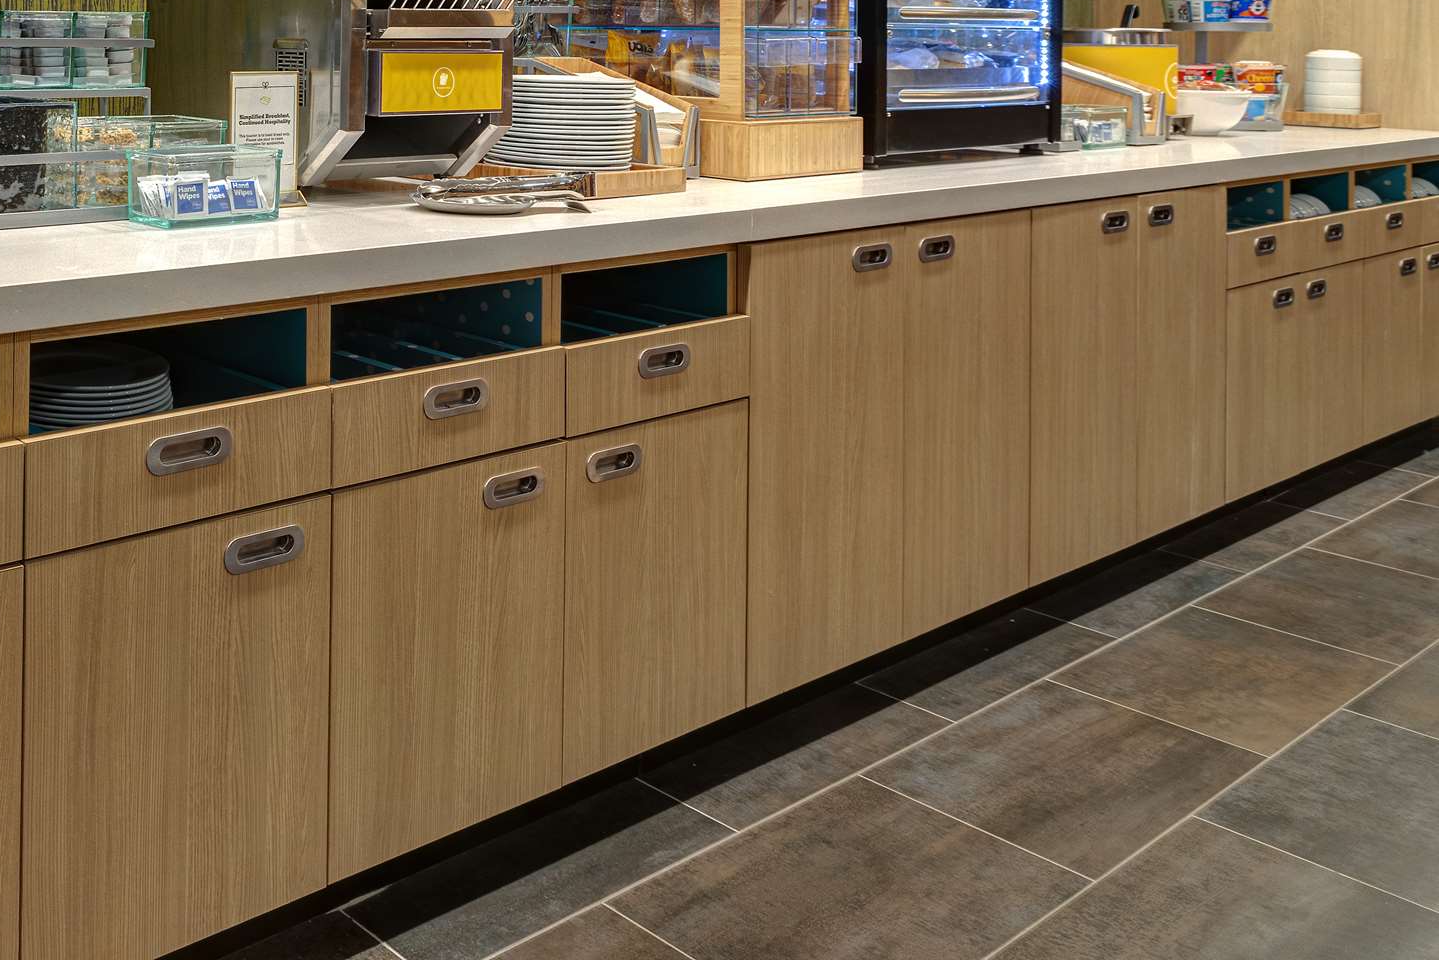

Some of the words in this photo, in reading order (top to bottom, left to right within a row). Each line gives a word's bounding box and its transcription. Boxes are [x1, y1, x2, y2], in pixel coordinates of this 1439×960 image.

[177, 185, 197, 193] Hand
[232, 181, 250, 189] Hand
[233, 188, 253, 197] Wipes
[178, 193, 200, 201] Wipes
